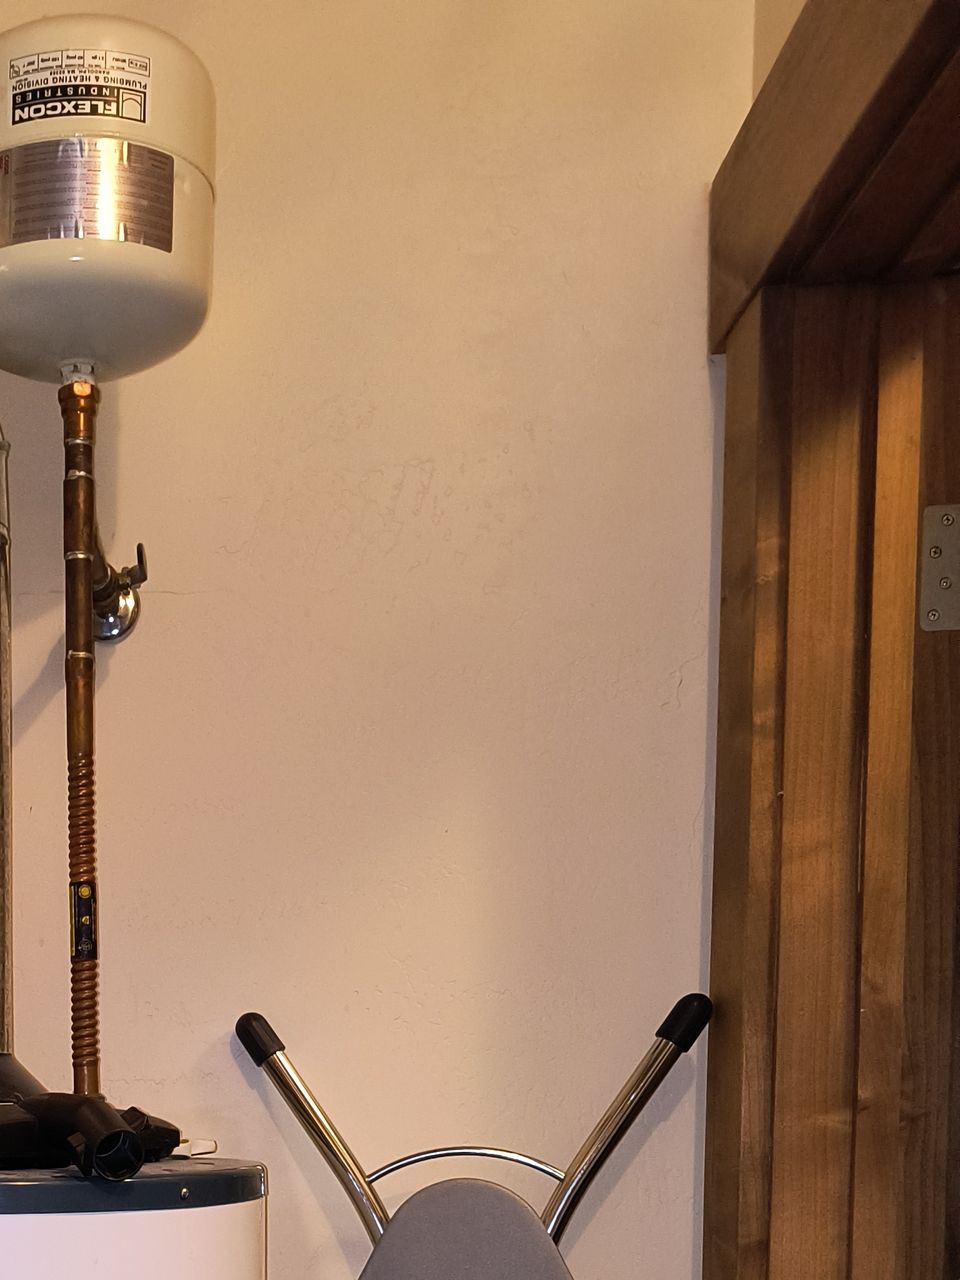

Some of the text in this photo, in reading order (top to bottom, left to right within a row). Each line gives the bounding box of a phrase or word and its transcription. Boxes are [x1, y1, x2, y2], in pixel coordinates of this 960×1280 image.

[12, 77, 48, 92] DIVISION
[52, 75, 91, 83] HEATING
[104, 76, 147, 90] PLUMBING
[16, 86, 117, 103] INDUSTRIES
[15, 101, 117, 121] FLEXCON
